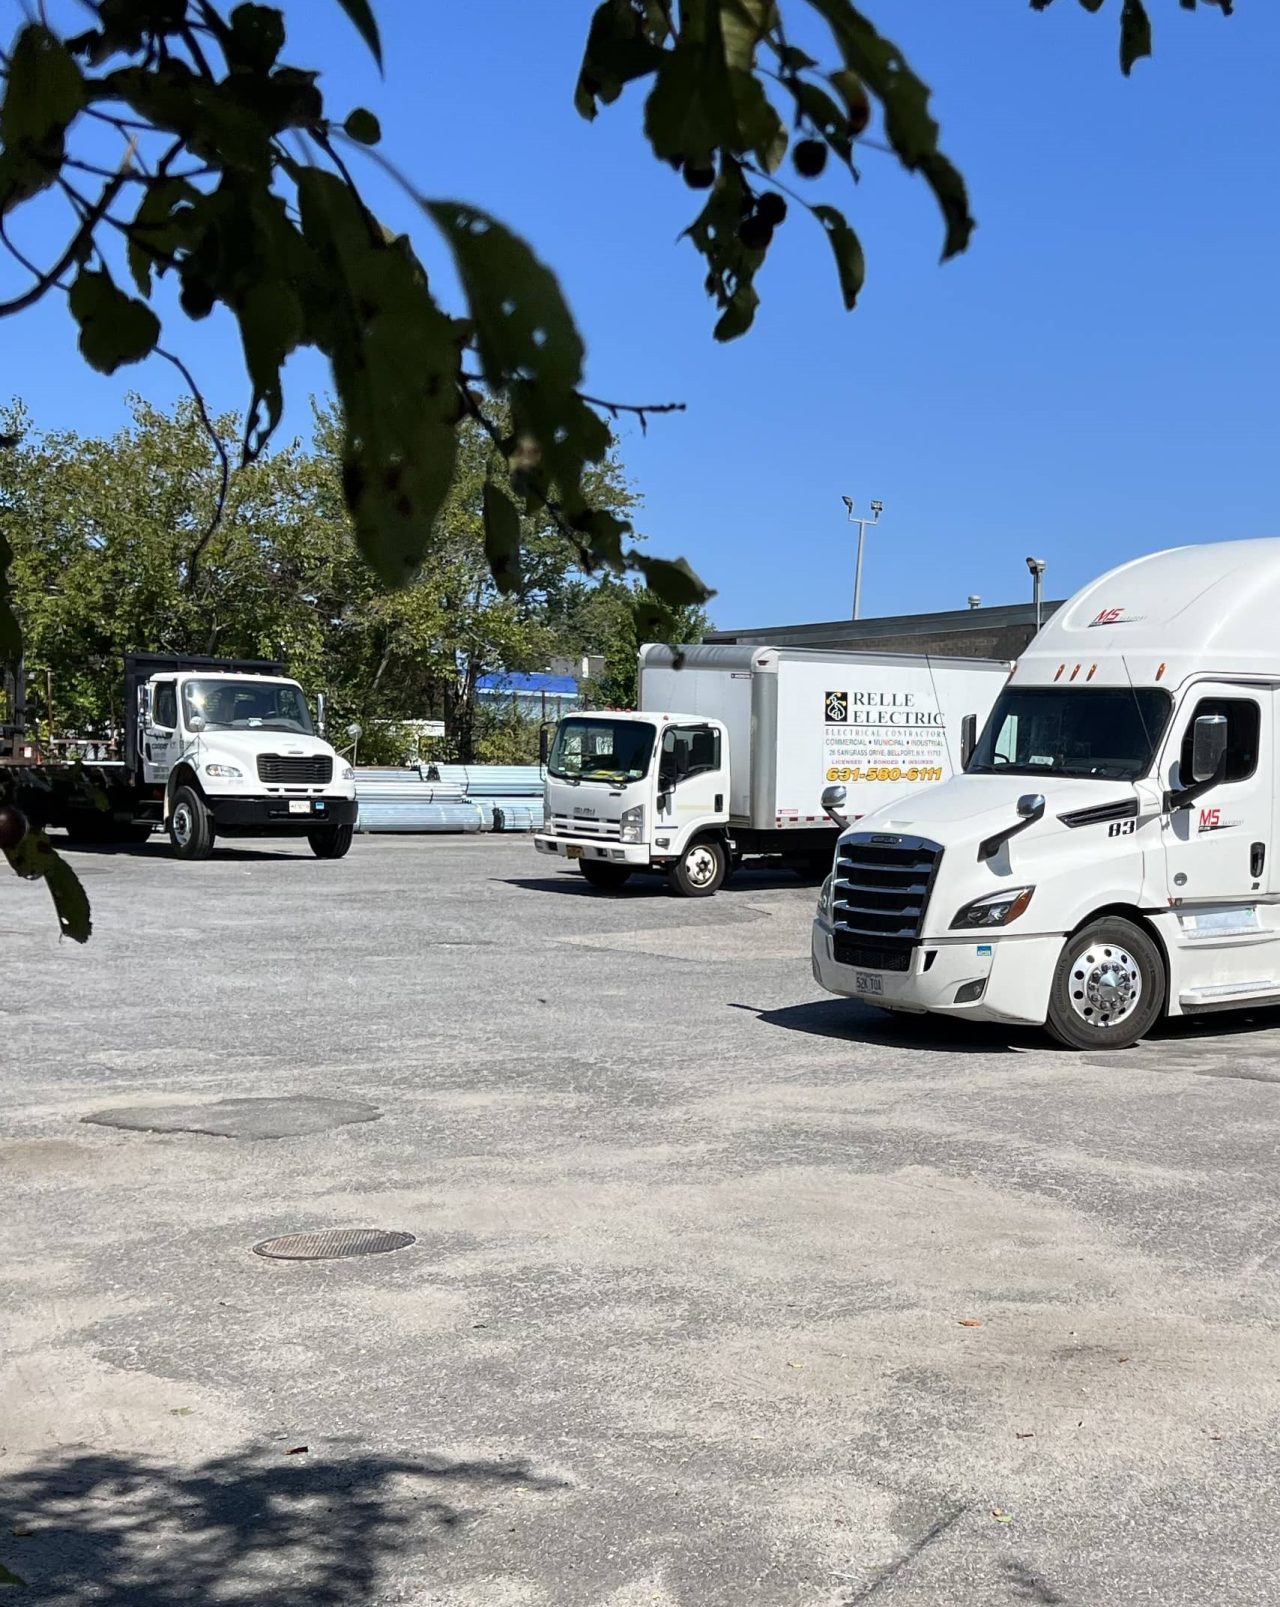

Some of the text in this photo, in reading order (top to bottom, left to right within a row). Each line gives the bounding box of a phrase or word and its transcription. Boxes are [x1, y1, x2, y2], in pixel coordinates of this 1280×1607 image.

[1093, 608, 1125, 622] MS
[853, 692, 915, 707] RELLE
[853, 710, 945, 725] ELECTRIC
[825, 728, 881, 737] ELECTRICAL
[825, 738, 867, 746] COMMERCIAL
[910, 739, 944, 747] INDUSTRIAL
[826, 767, 942, 782] 631-580-6111
[1199, 808, 1221, 825] MS
[1108, 820, 1135, 837] 83
